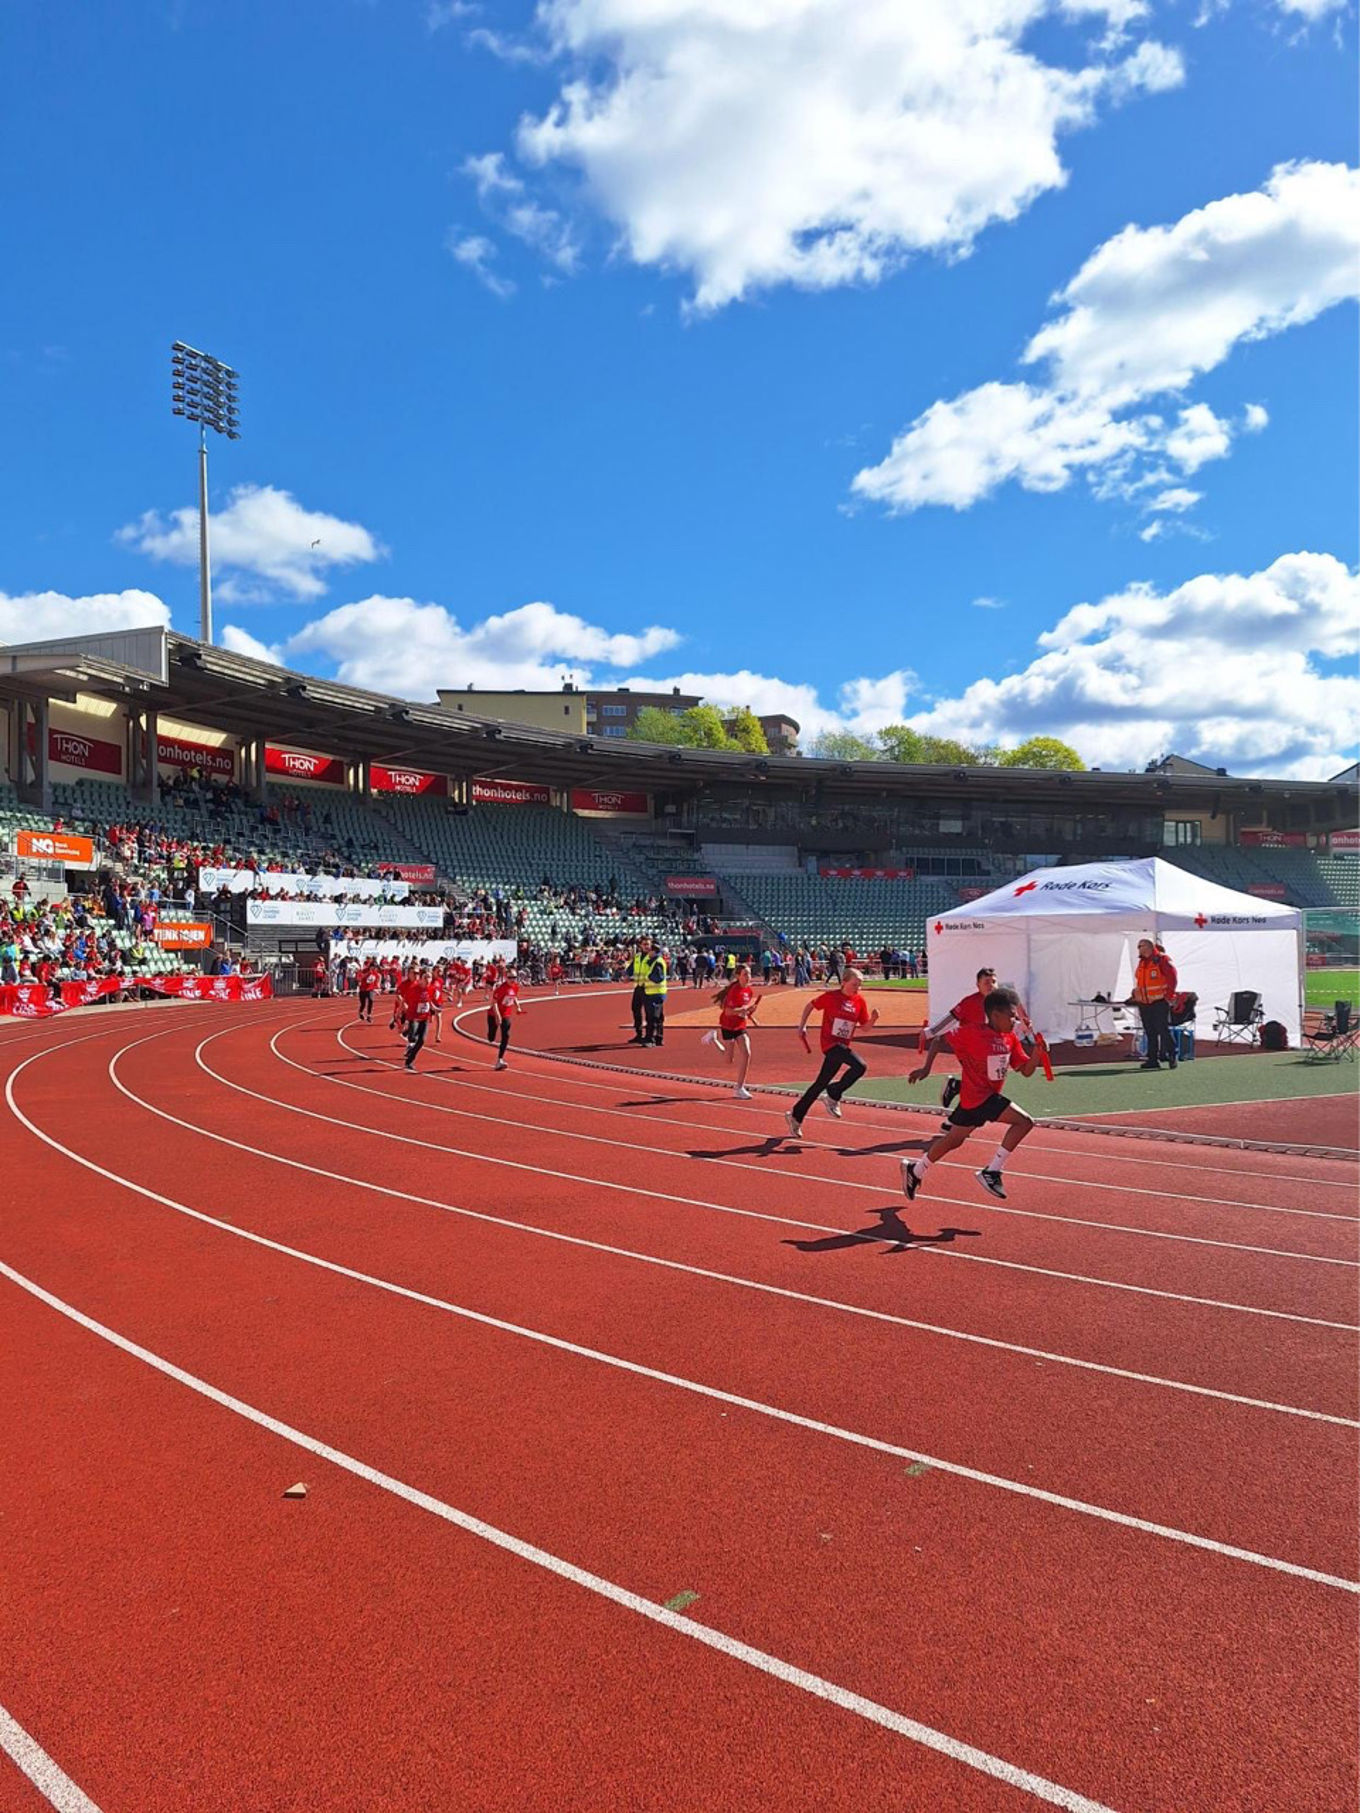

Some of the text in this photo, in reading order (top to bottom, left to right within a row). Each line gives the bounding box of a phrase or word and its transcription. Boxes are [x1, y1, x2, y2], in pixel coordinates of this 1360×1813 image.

[53, 734, 94, 757] THON
[61, 755, 86, 766] HOTELS
[158, 745, 232, 770] onhotels.no
[281, 753, 319, 771] THON
[387, 771, 424, 786] THON
[472, 784, 548, 802] thonhotels.no
[592, 792, 625, 805] THON
[32, 838, 54, 854] NG
[1077, 880, 1111, 890] Kors
[1232, 916, 1250, 924] Kors
